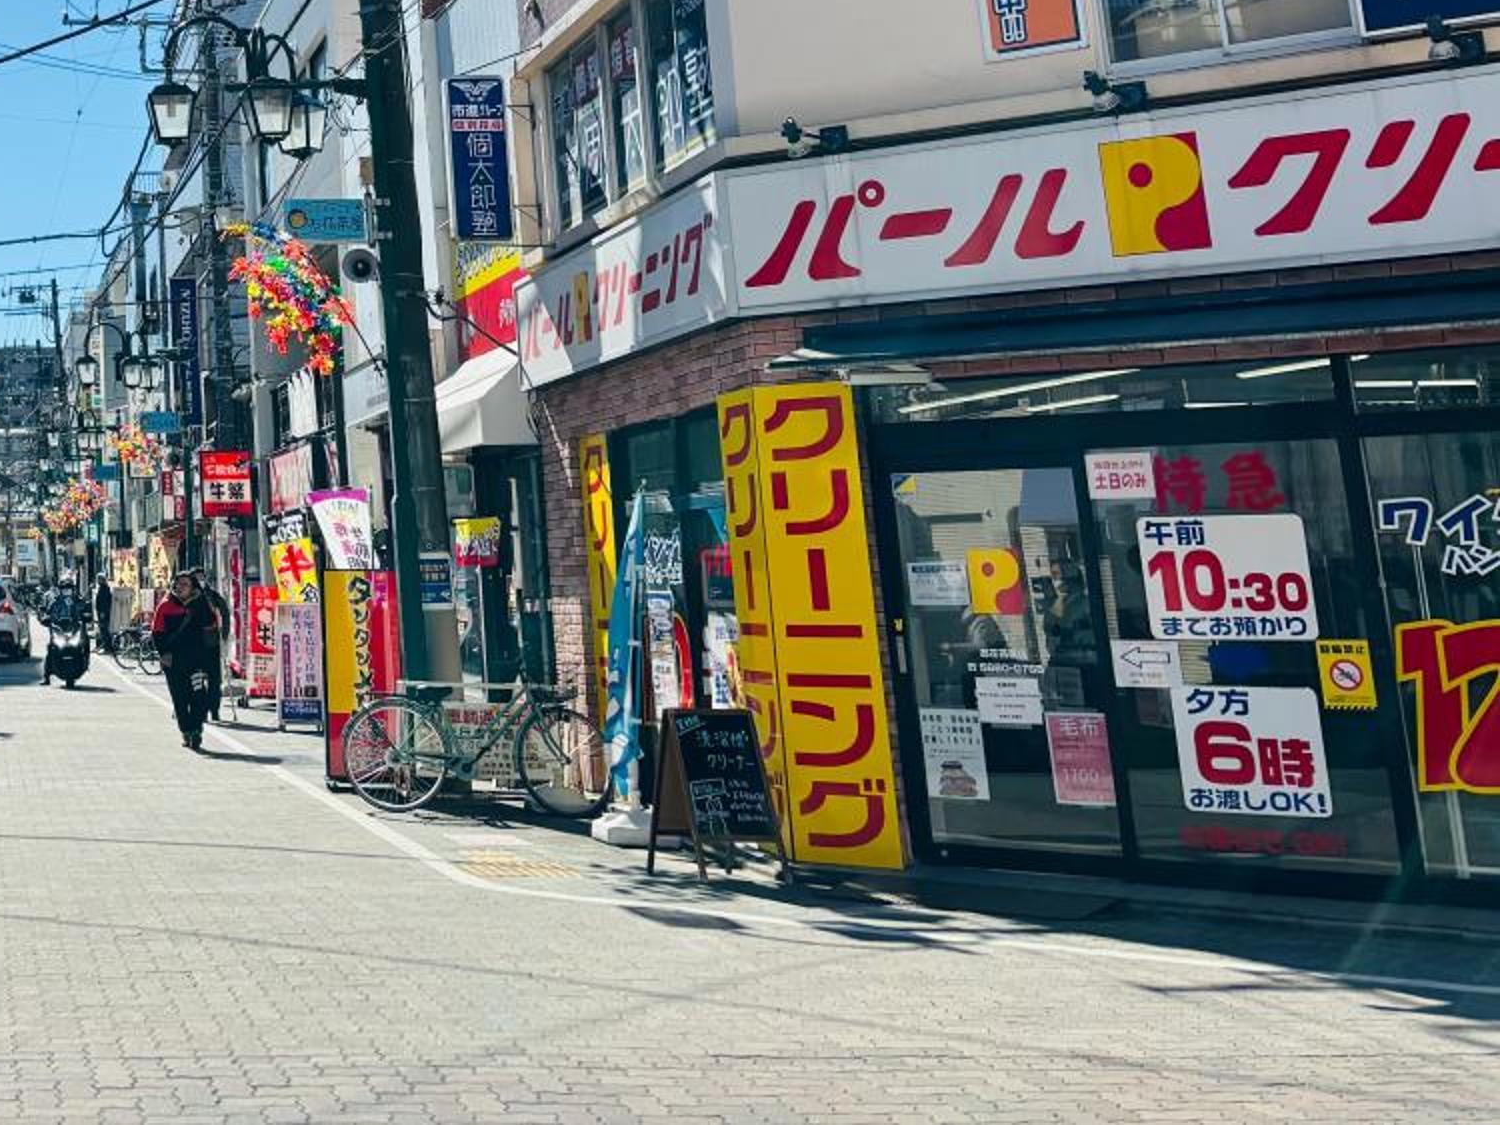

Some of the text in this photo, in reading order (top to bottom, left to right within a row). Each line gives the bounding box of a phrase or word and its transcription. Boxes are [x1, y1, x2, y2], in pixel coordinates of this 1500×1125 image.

[467, 132, 499, 236] 個太郎塾
[745, 168, 1085, 287] パール
[523, 292, 575, 363] パール
[593, 212, 712, 332] クリーニング
[1094, 472, 1147, 491] 土日のみ
[1153, 451, 1285, 515] 特急
[1144, 519, 1206, 546] 午前
[1378, 493, 1500, 546] ワイ
[1148, 549, 1309, 612] 10:30
[764, 396, 886, 847] クリーニング
[1160, 616, 1308, 637] までお預かり
[1059, 717, 1098, 738] 毛布
[1185, 689, 1250, 716] 夕方
[1189, 788, 1329, 814] お渡しOK!
